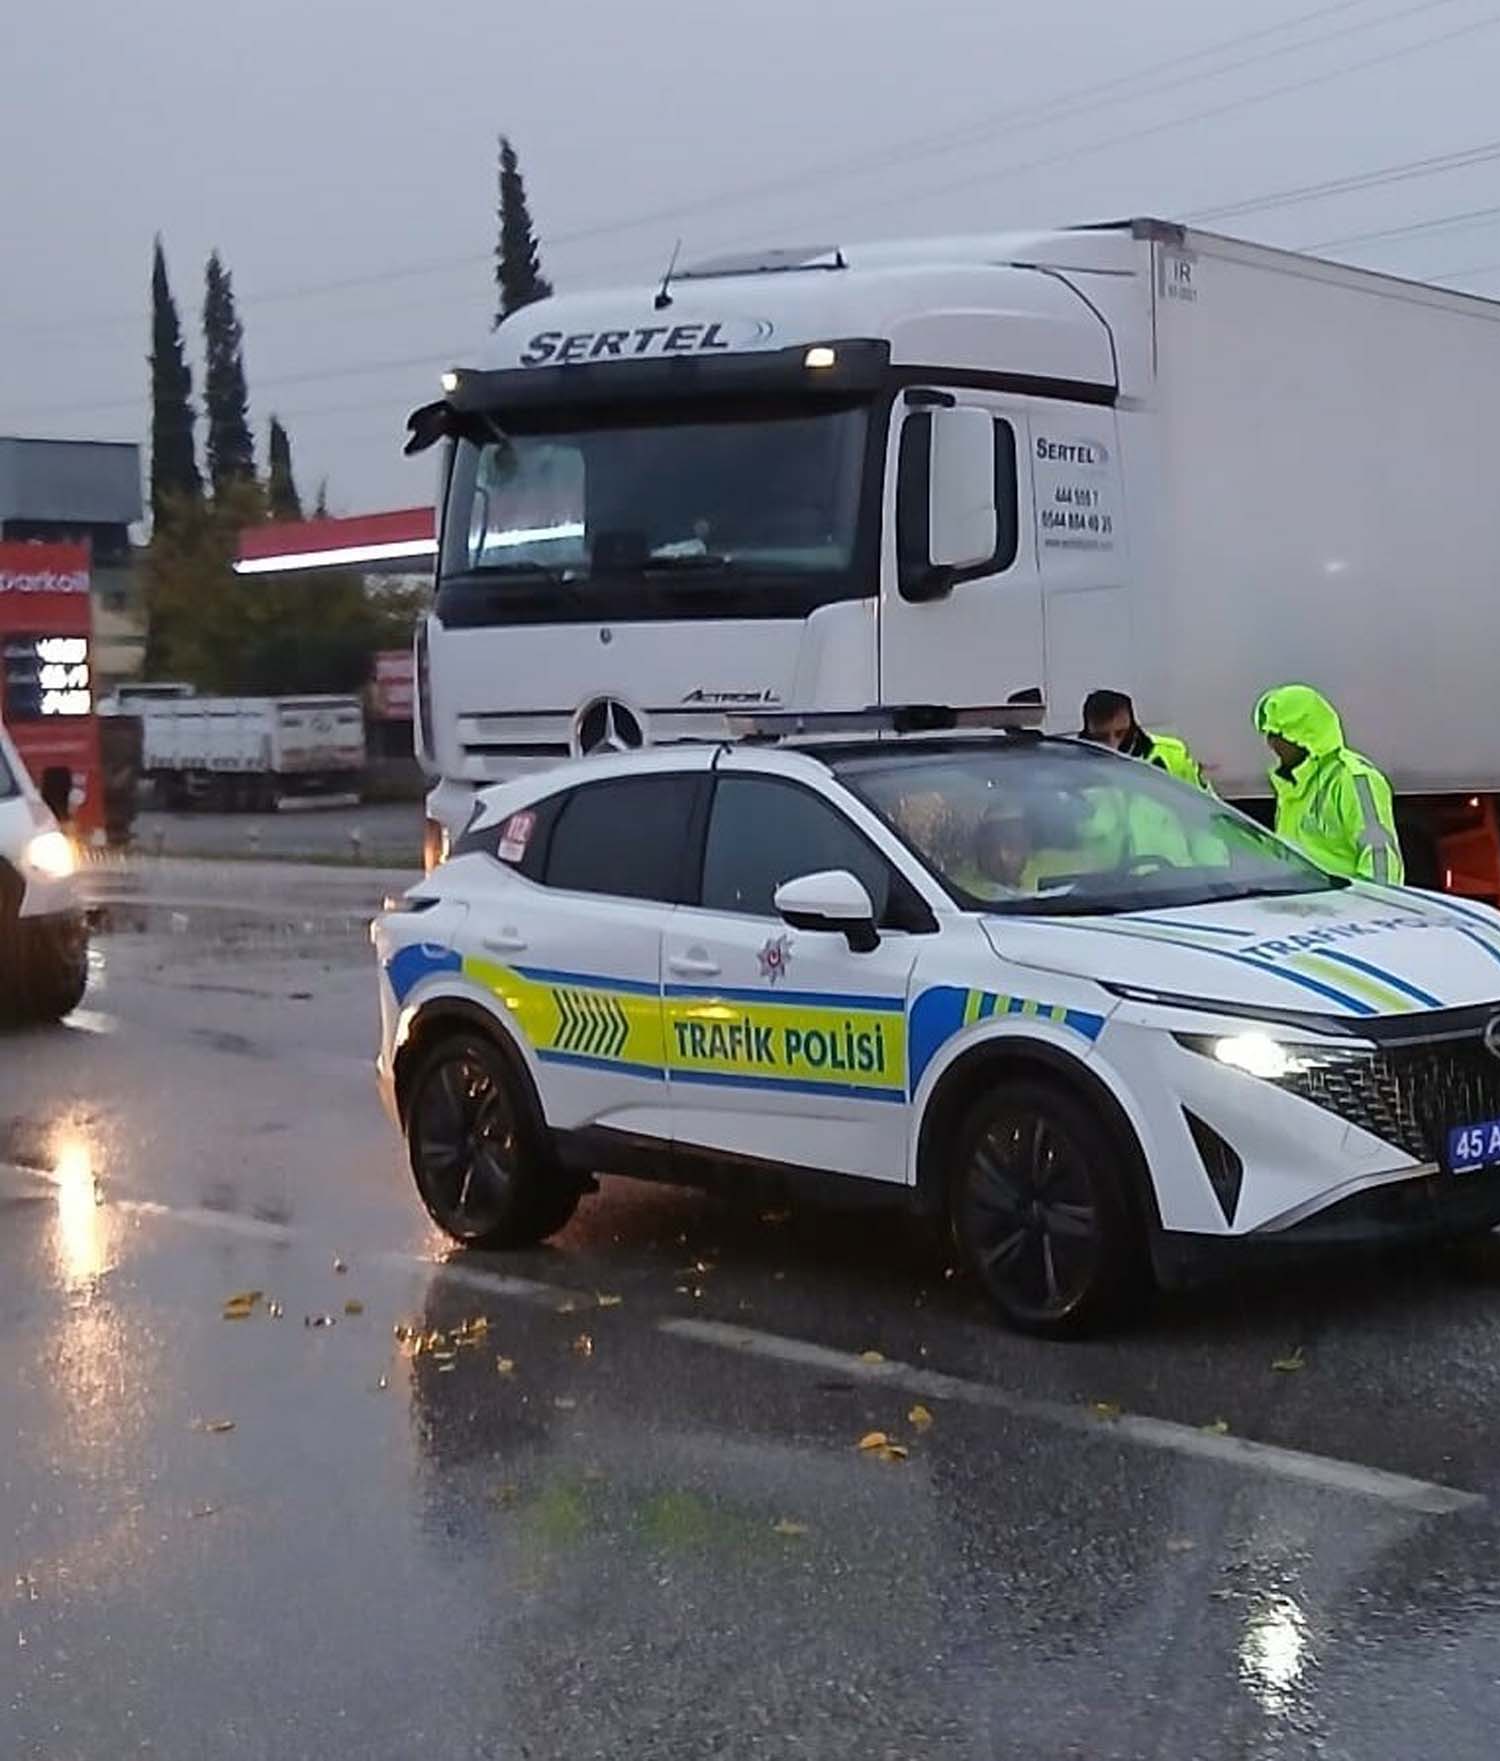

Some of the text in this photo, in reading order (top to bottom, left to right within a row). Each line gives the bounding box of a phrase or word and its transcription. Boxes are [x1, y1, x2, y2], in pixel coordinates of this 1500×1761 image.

[1173, 260, 1191, 283] IR
[520, 323, 728, 367] SERTEL
[1036, 437, 1095, 464] SERTEL
[674, 1016, 885, 1073] TRAFİK POLİSİ
[1455, 1129, 1483, 1160] 45
